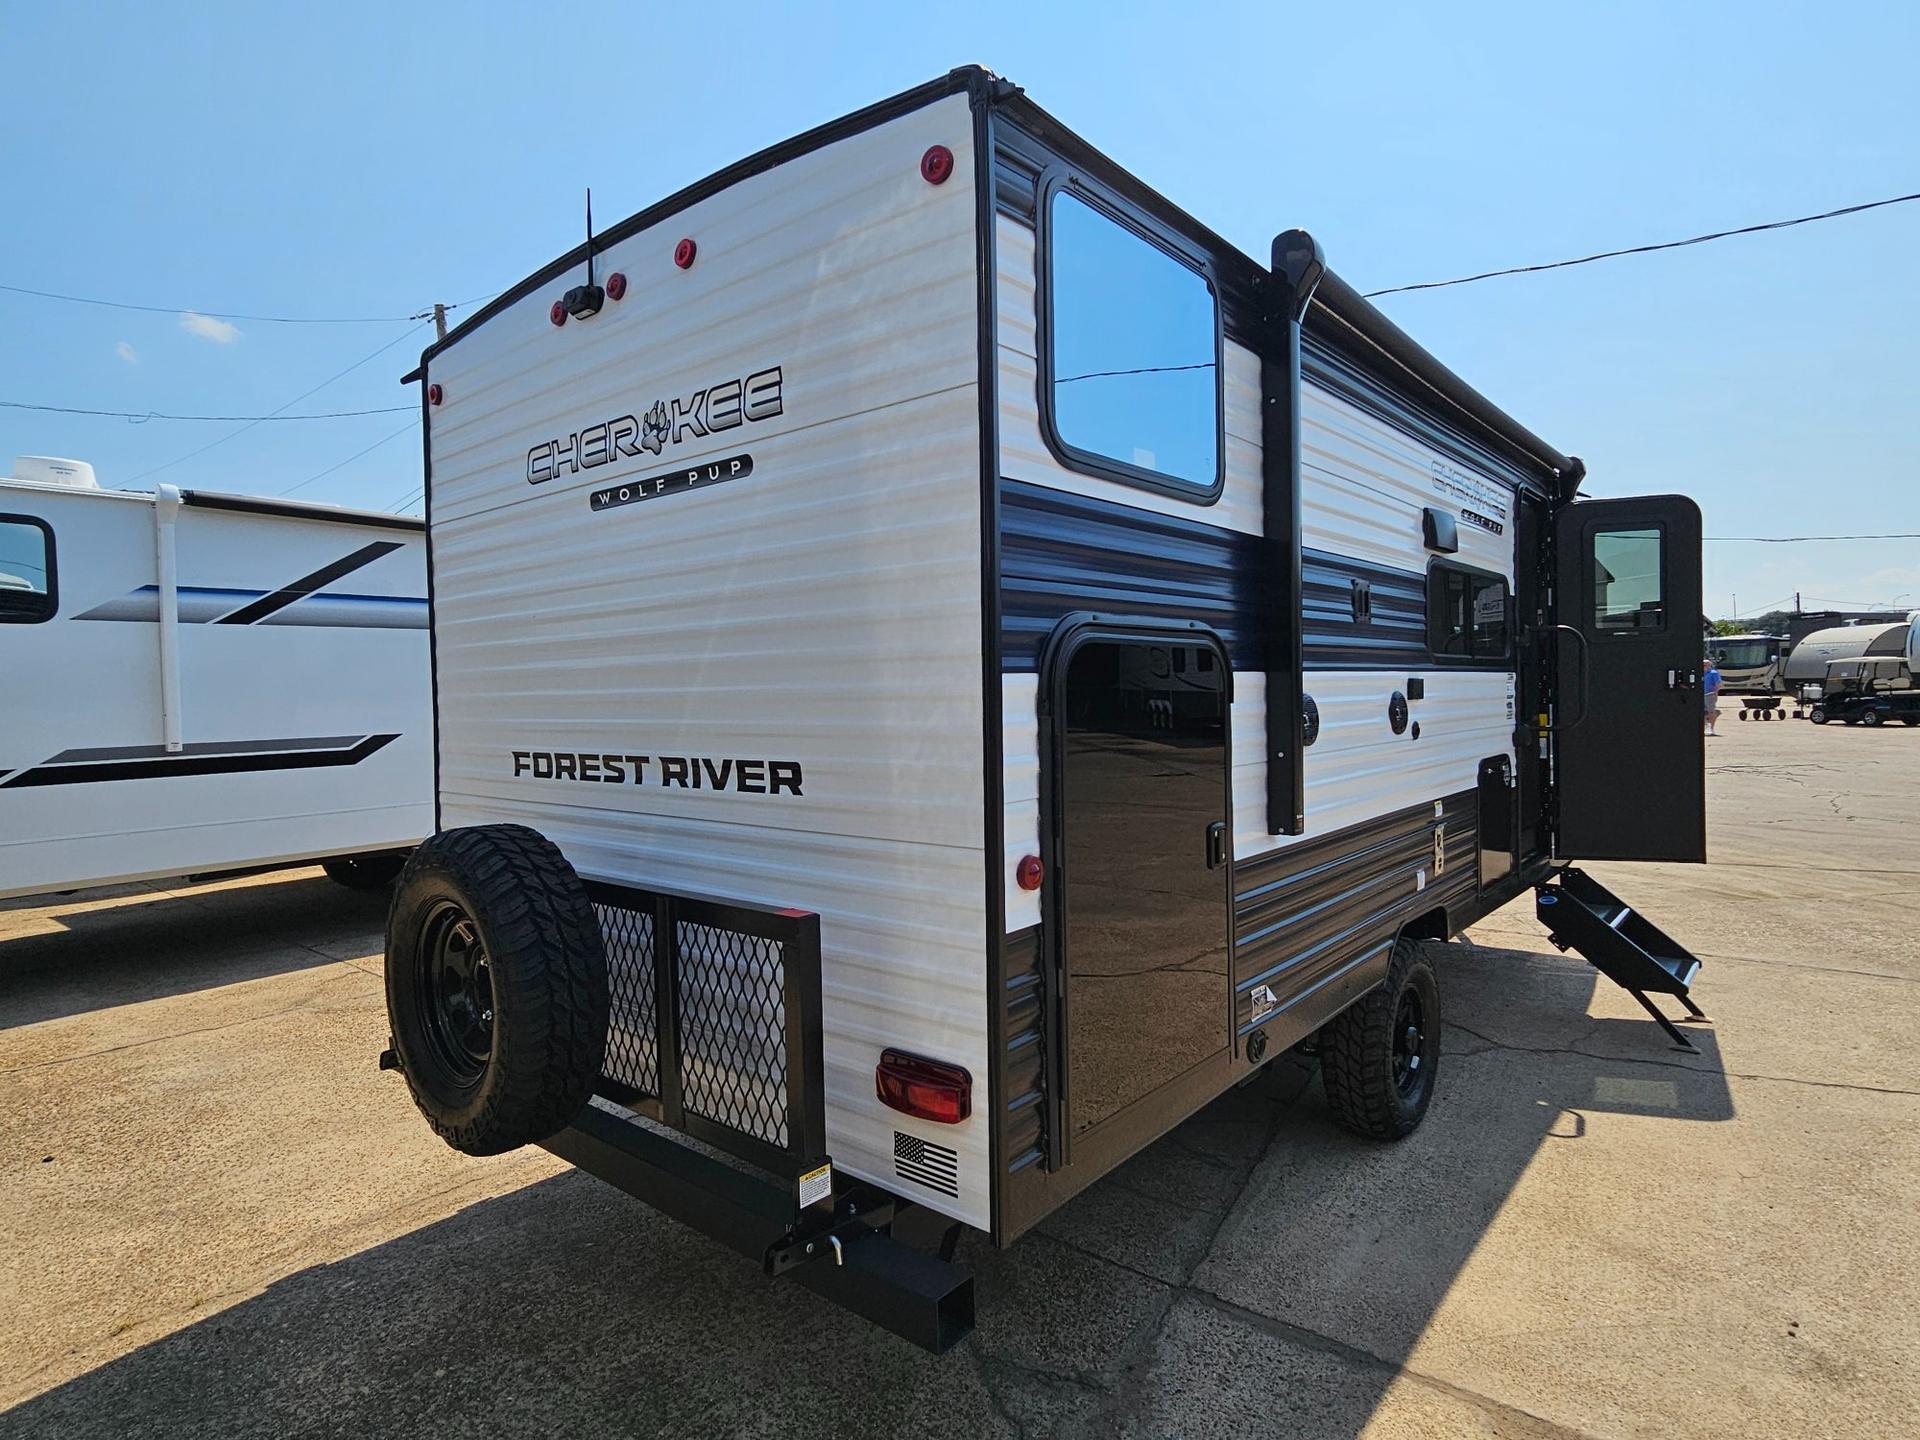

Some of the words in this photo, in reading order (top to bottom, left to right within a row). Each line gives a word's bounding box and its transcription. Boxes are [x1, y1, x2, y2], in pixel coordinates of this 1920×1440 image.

[598, 479, 665, 506] WOLF
[688, 459, 742, 486] PUP
[511, 751, 650, 785] FOREST
[658, 756, 804, 796] RIVER
